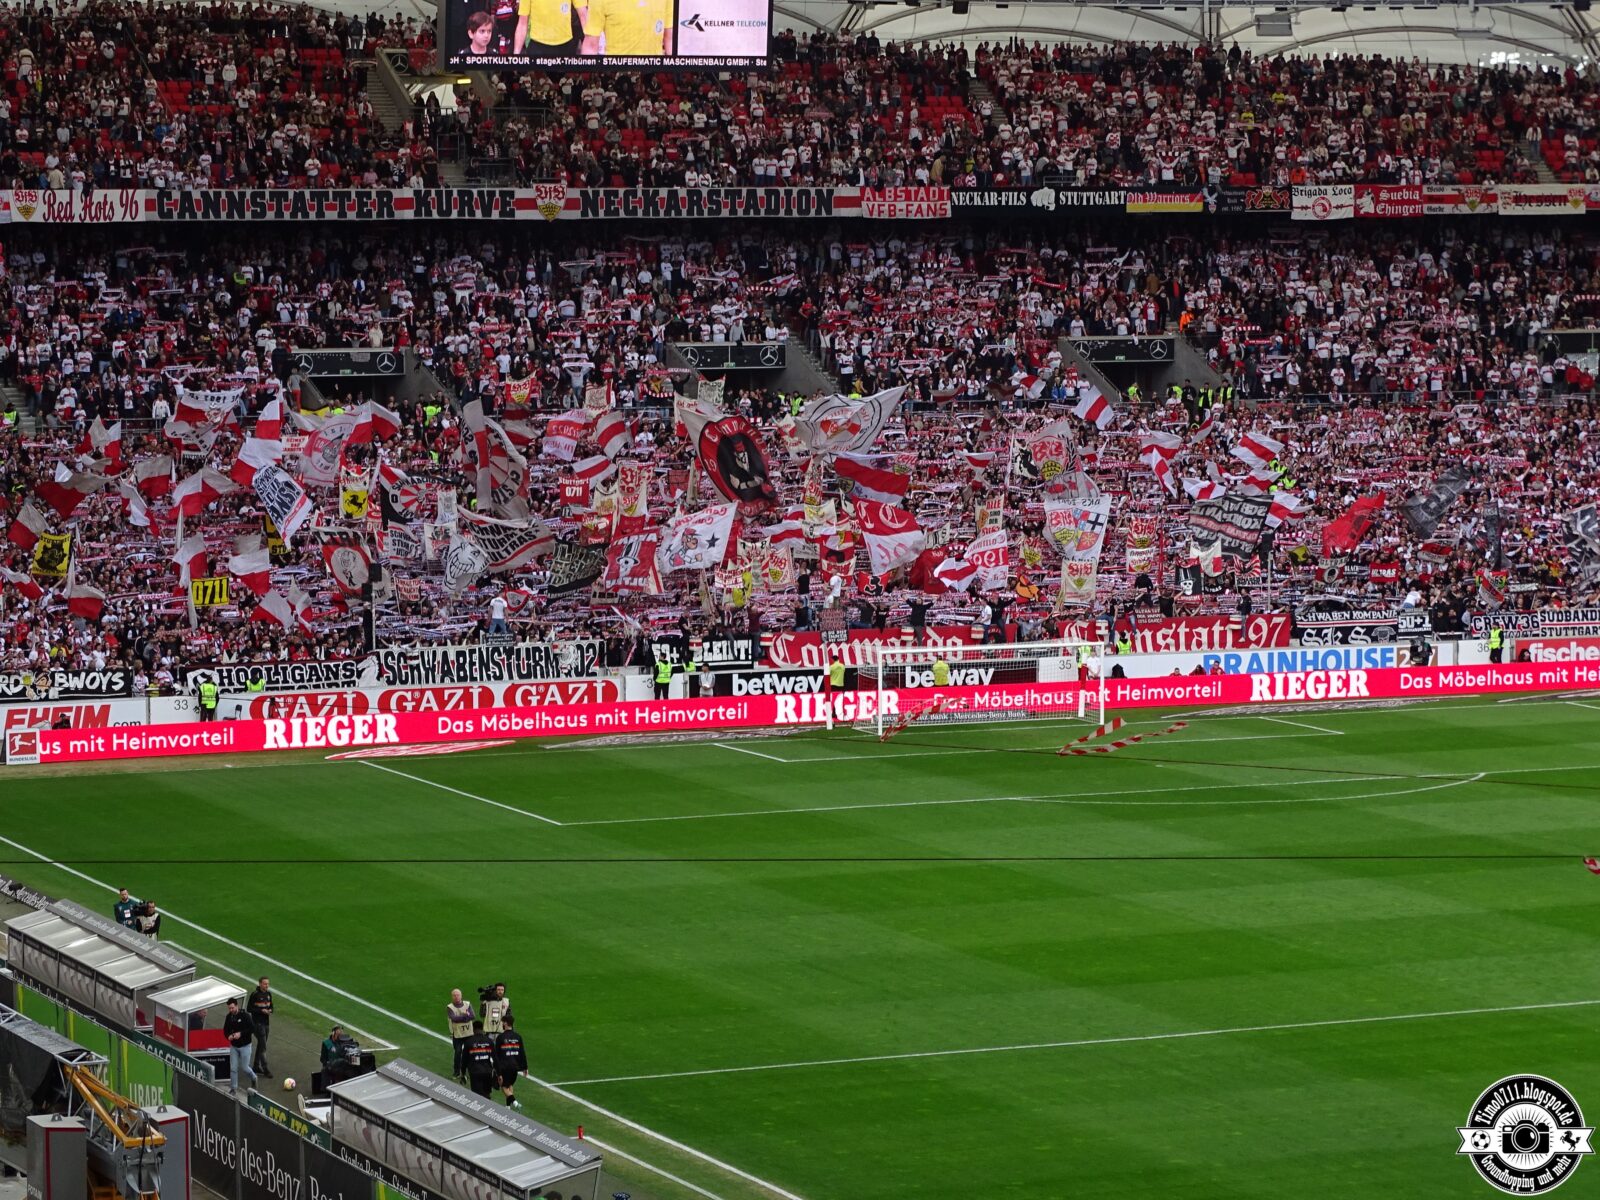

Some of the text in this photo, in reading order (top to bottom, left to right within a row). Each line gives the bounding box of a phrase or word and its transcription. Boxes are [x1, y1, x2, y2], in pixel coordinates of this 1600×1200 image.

[466, 56, 530, 65] SPORTKULTOUR
[602, 57, 661, 66] STAUFERMATIC
[663, 57, 725, 66] MASCHINENBAU
[726, 58, 750, 66] GMBH
[864, 186, 950, 202] ALBSTADT
[951, 190, 1127, 206] NECKAR-FILS STUTTGART
[1145, 191, 1191, 204] Warriors
[1291, 185, 1353, 198] Brigada Loca
[1378, 188, 1420, 201] Suebia
[42, 187, 139, 223] Red Hots 96
[157, 189, 516, 220] CANNSTATTER KURVE
[580, 188, 835, 218] NECKARSTADION
[866, 201, 948, 218] VFB-FANS
[1376, 202, 1423, 217] Ehingen
[565, 486, 582, 498] 0711
[192, 581, 229, 604] 0711
[1295, 609, 1398, 622] SCHWABEN KOMPANIE
[1521, 615, 1540, 629] 36
[1248, 616, 1286, 648] 97
[1058, 659, 1072, 670] 35
[1203, 647, 1394, 675] BRAINHOUSE
[54, 670, 125, 692] BWOYS
[215, 660, 357, 687] HOOLIGANS
[732, 673, 825, 696] betway
[905, 666, 994, 689] beway
[1399, 673, 1433, 689] Das
[1439, 669, 1534, 689] Möbelhaus
[1539, 668, 1568, 684] mit
[974, 689, 1074, 708] Möbelhaus
[1117, 681, 1222, 701] Heimvorteil
[1250, 670, 1370, 701] RIEGER
[174, 699, 189, 710] 33
[437, 702, 748, 734] Das Möbelhaus mit Heimvorteil
[69, 734, 105, 753] mit
[112, 727, 234, 750] Heimvorteil
[262, 713, 400, 749] RIEGER
